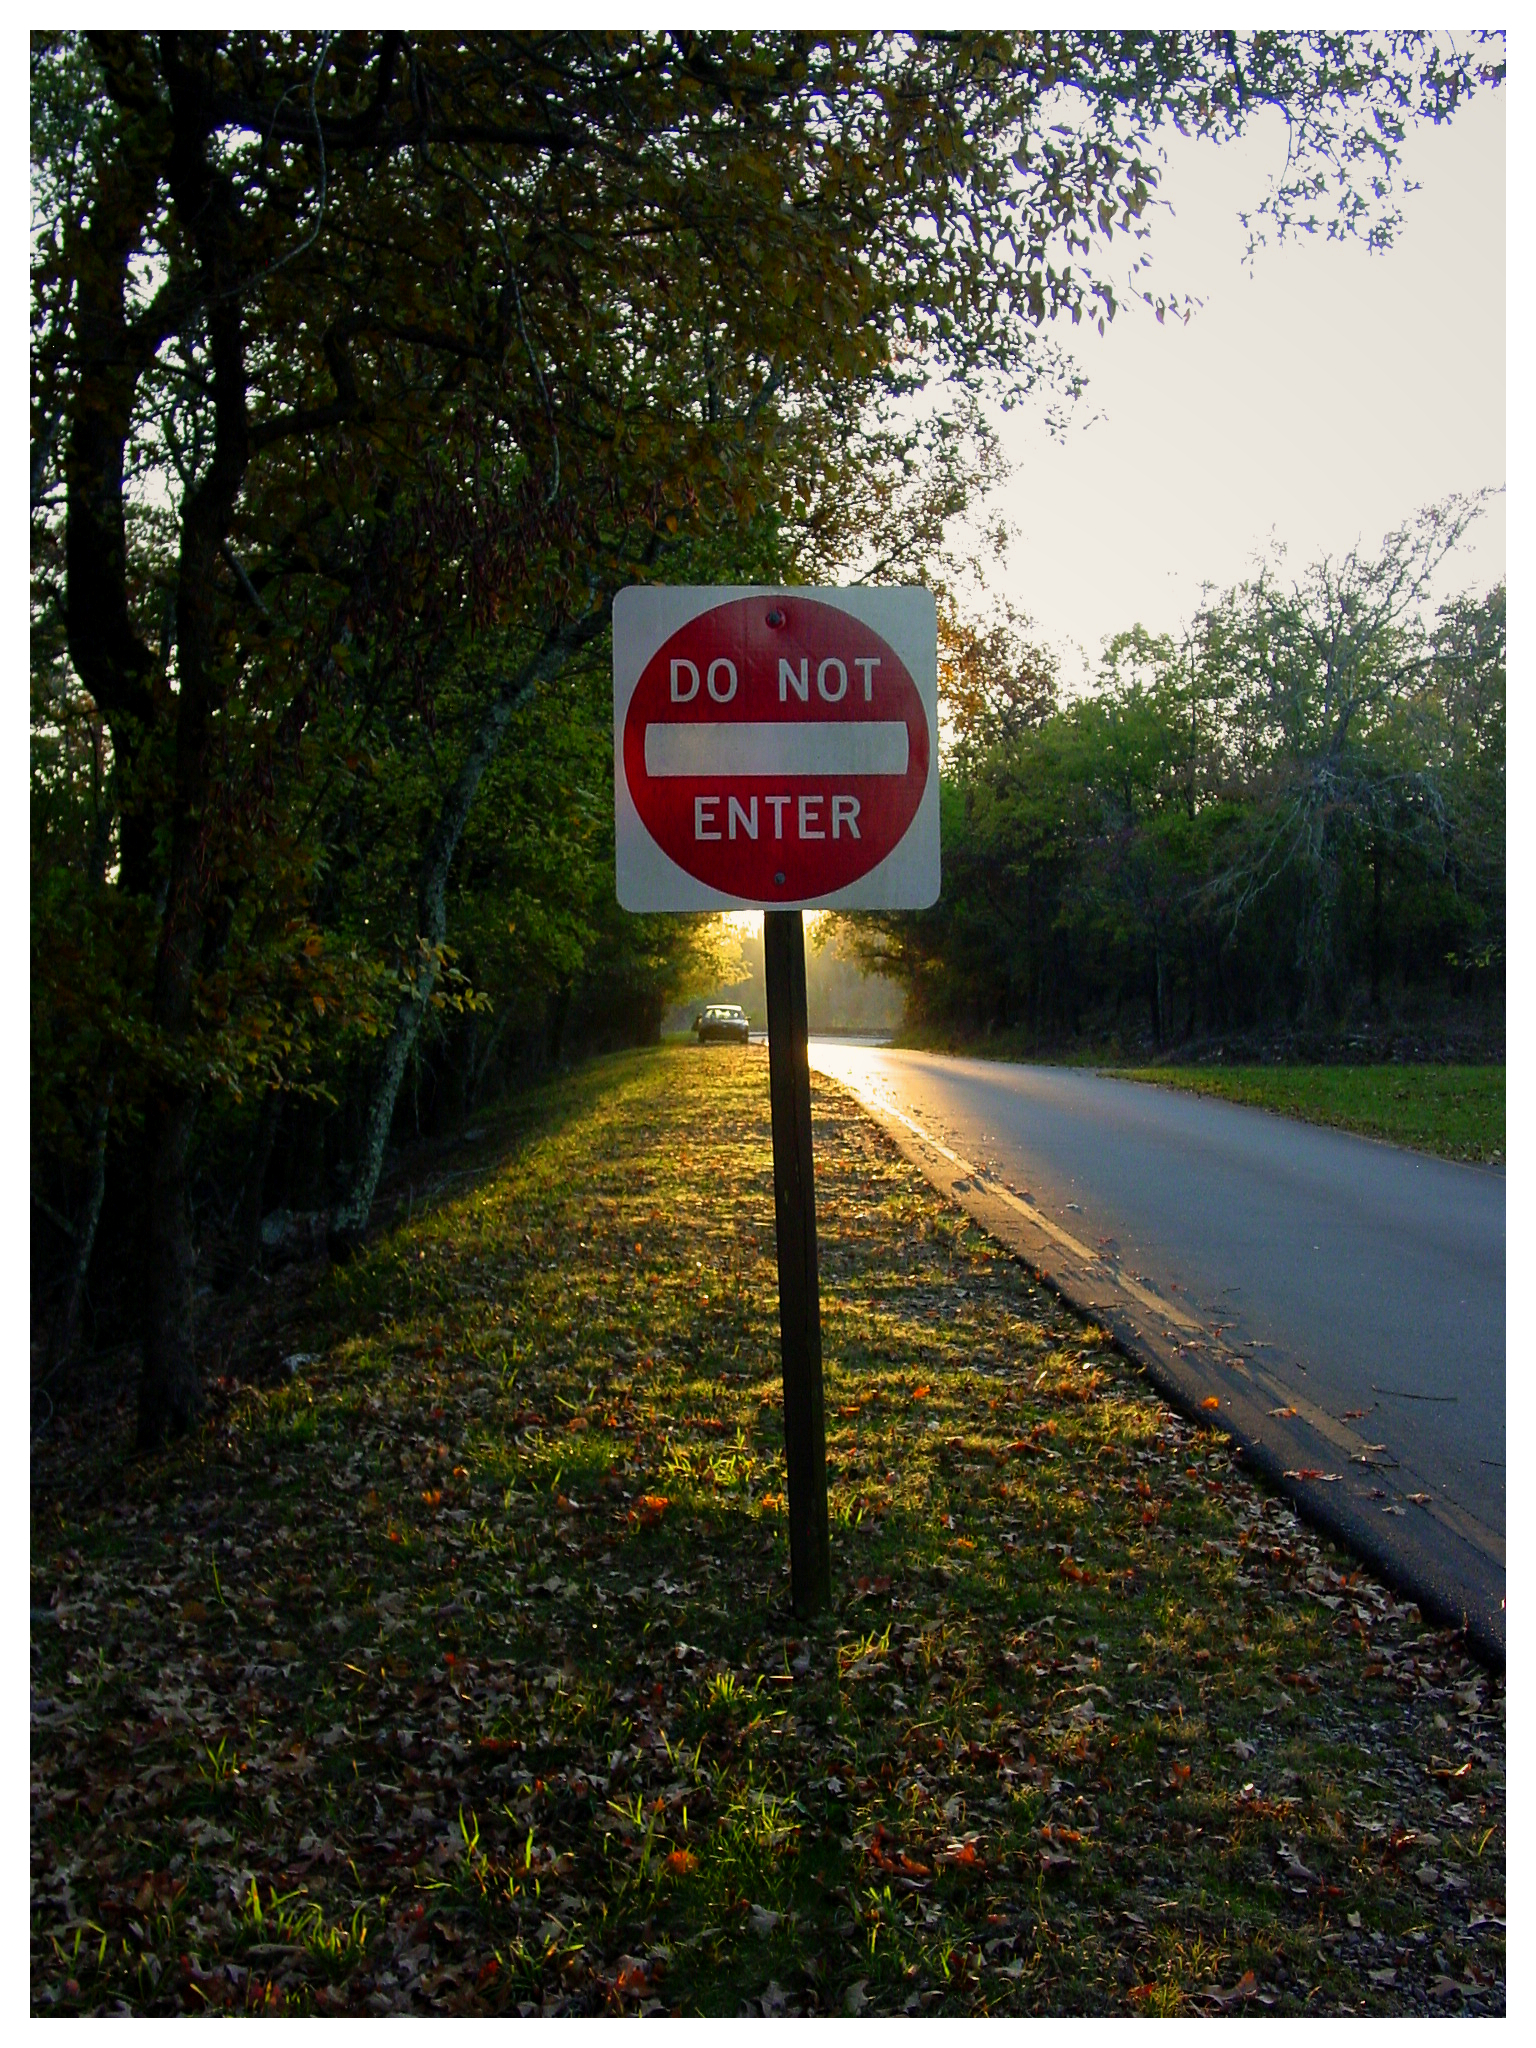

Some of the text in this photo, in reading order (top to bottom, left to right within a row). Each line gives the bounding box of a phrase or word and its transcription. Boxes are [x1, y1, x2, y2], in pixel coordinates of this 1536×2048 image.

[669, 657, 882, 703] DO NOT
[694, 795, 862, 840] ENTER
